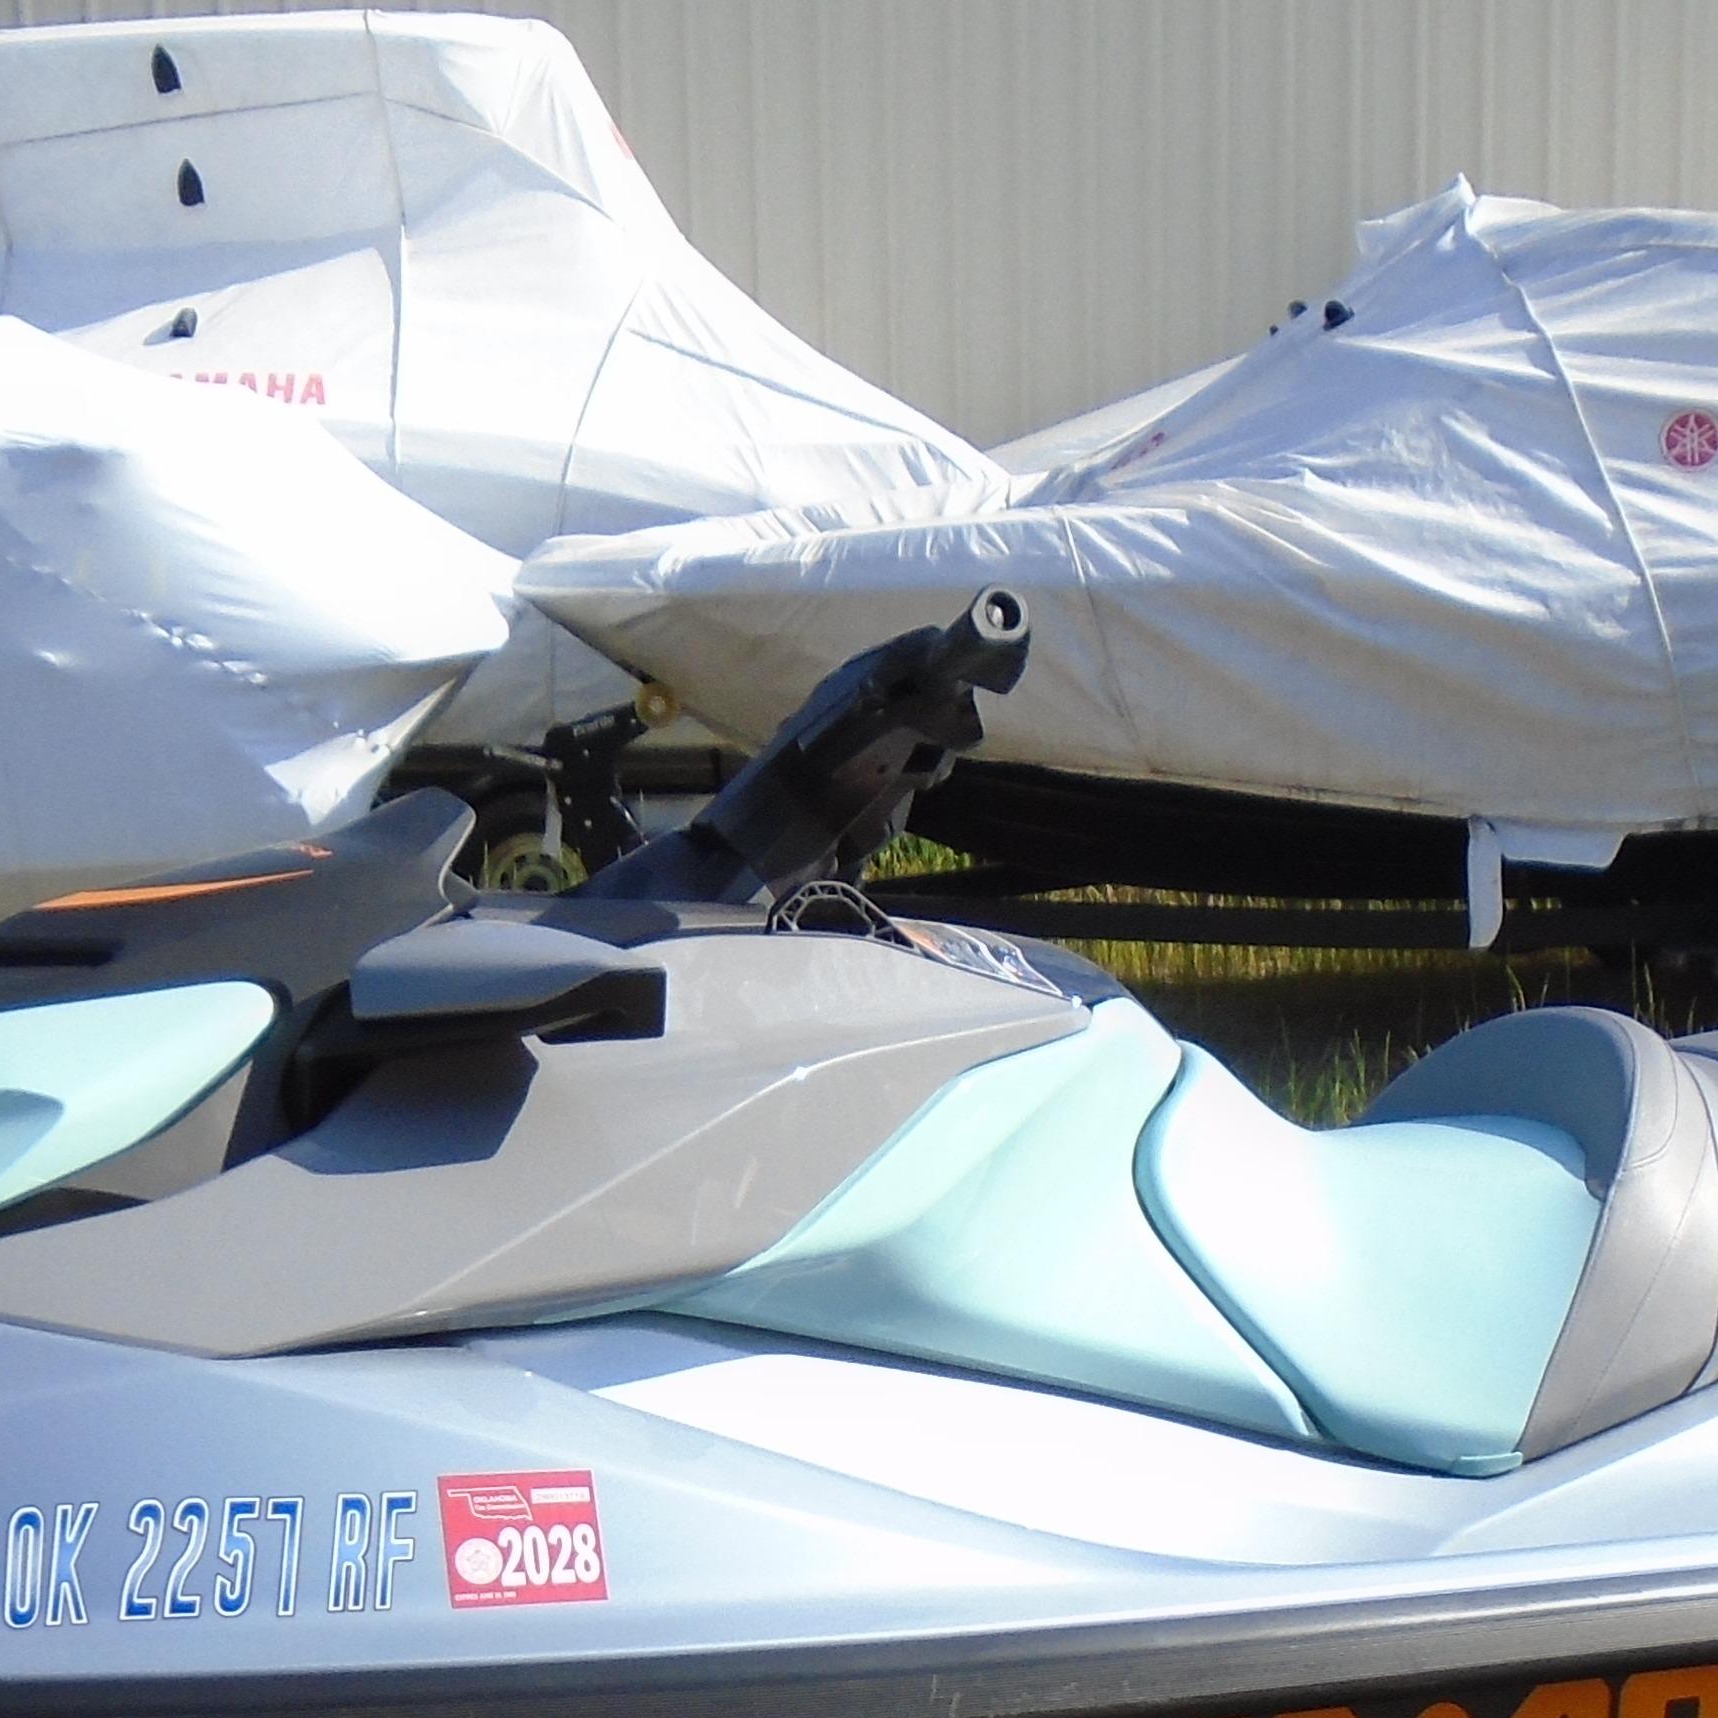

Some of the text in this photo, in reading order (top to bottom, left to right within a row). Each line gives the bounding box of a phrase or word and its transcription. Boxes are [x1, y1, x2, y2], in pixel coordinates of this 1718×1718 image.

[3, 1490, 418, 1628] OK 2257 RF
[497, 1523, 601, 1587] 2028
